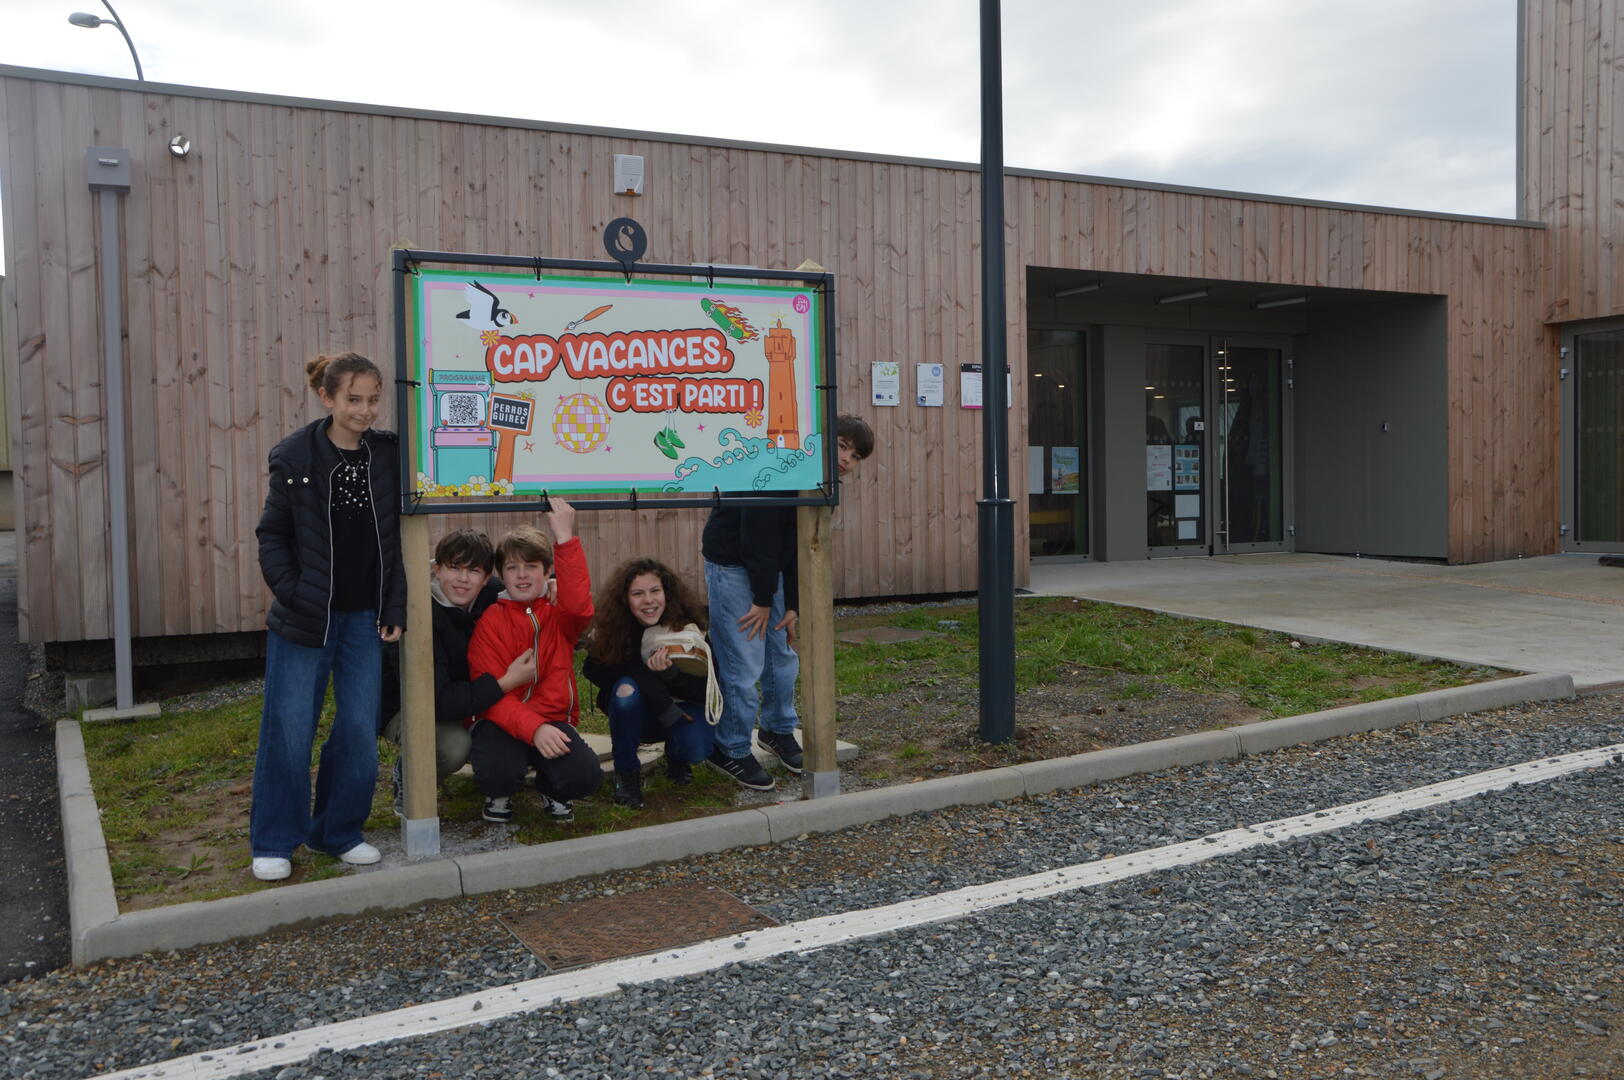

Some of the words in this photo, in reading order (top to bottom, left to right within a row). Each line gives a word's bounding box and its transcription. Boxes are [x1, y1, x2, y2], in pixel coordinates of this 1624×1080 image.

[493, 342, 554, 375] CAP
[565, 336, 728, 372] VACANCES,
[439, 373, 486, 382] PROGRAMME
[685, 383, 745, 407] PARTI
[493, 402, 529, 417] PERROS
[492, 411, 526, 425] GUIREC
